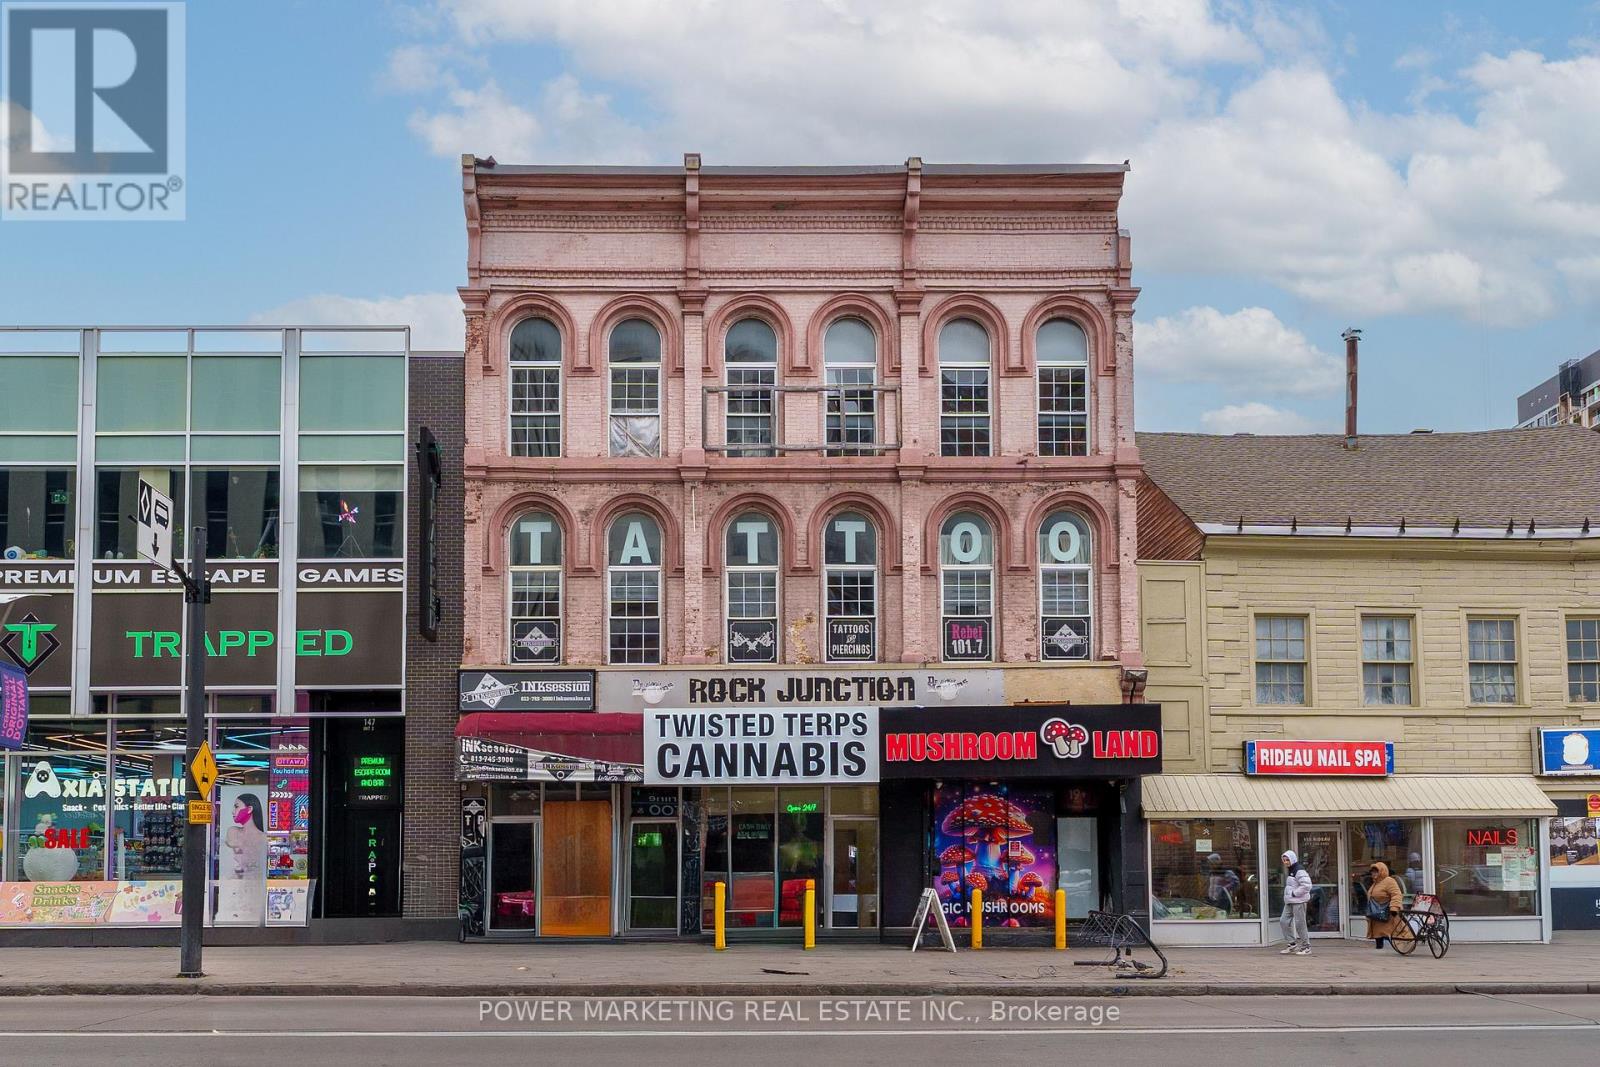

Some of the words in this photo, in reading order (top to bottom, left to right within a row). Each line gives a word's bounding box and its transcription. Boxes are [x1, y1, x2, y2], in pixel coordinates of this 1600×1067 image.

[0, 569, 140, 584] REMIUM
[151, 569, 265, 584] ESAPE
[299, 568, 404, 584] GAMES
[832, 624, 870, 634] TATTOOS
[951, 624, 983, 639] Rebel
[832, 644, 871, 655] PIERCINGS
[951, 639, 983, 654] 101.7
[521, 681, 591, 692] INKsession
[689, 678, 766, 703] ROCK
[776, 676, 915, 702] JUNCTION
[6, 677, 18, 738] ORIGINAL
[655, 713, 775, 737] TWISTED
[783, 712, 868, 736] TERPS
[886, 731, 1038, 762] MUSHROOM
[1093, 730, 1158, 758] LAND
[656, 742, 867, 778] CANNABIS
[1260, 748, 1313, 767] RIDEAU
[1317, 749, 1351, 767] NAIL
[1354, 749, 1382, 767] SPA
[62, 803, 83, 812] Snack
[133, 803, 154, 811] Better
[154, 803, 167, 811] Life
[44, 827, 90, 849] SALE
[1467, 829, 1518, 846] NAILS
[33, 884, 81, 895] Snacks
[32, 896, 77, 907] Drinks
